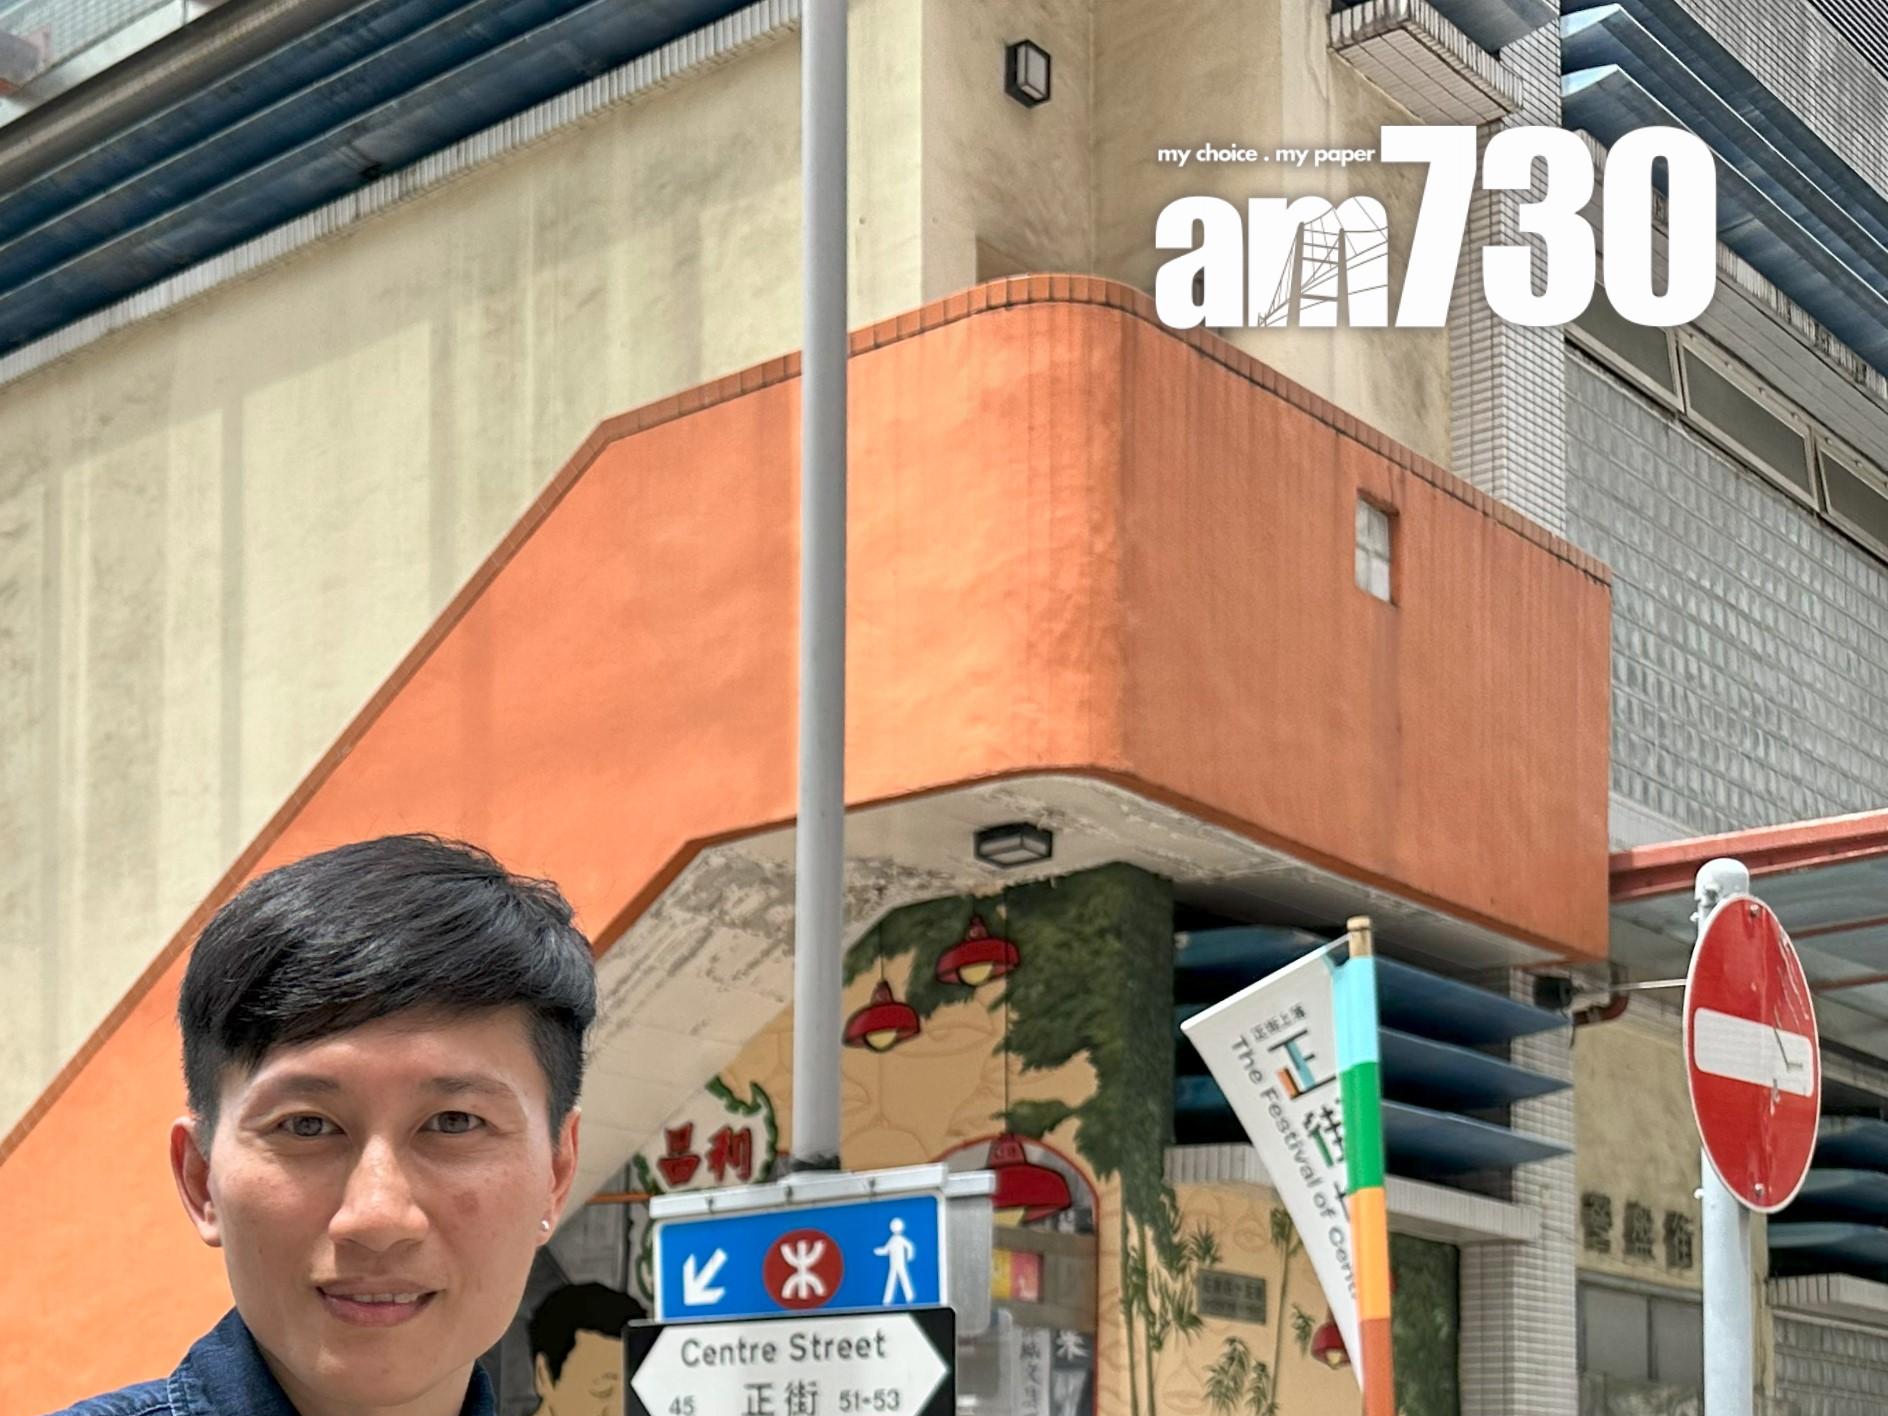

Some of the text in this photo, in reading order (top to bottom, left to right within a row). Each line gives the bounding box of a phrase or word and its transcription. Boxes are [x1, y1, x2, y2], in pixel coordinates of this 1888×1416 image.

[1232, 1035, 1263, 1084] The
[1260, 1087, 1323, 1188] Festival
[1313, 1192, 1336, 1218] of
[681, 1330, 887, 1368] Centre Street
[668, 1396, 695, 1416] 45
[839, 1389, 900, 1412] 51-53
